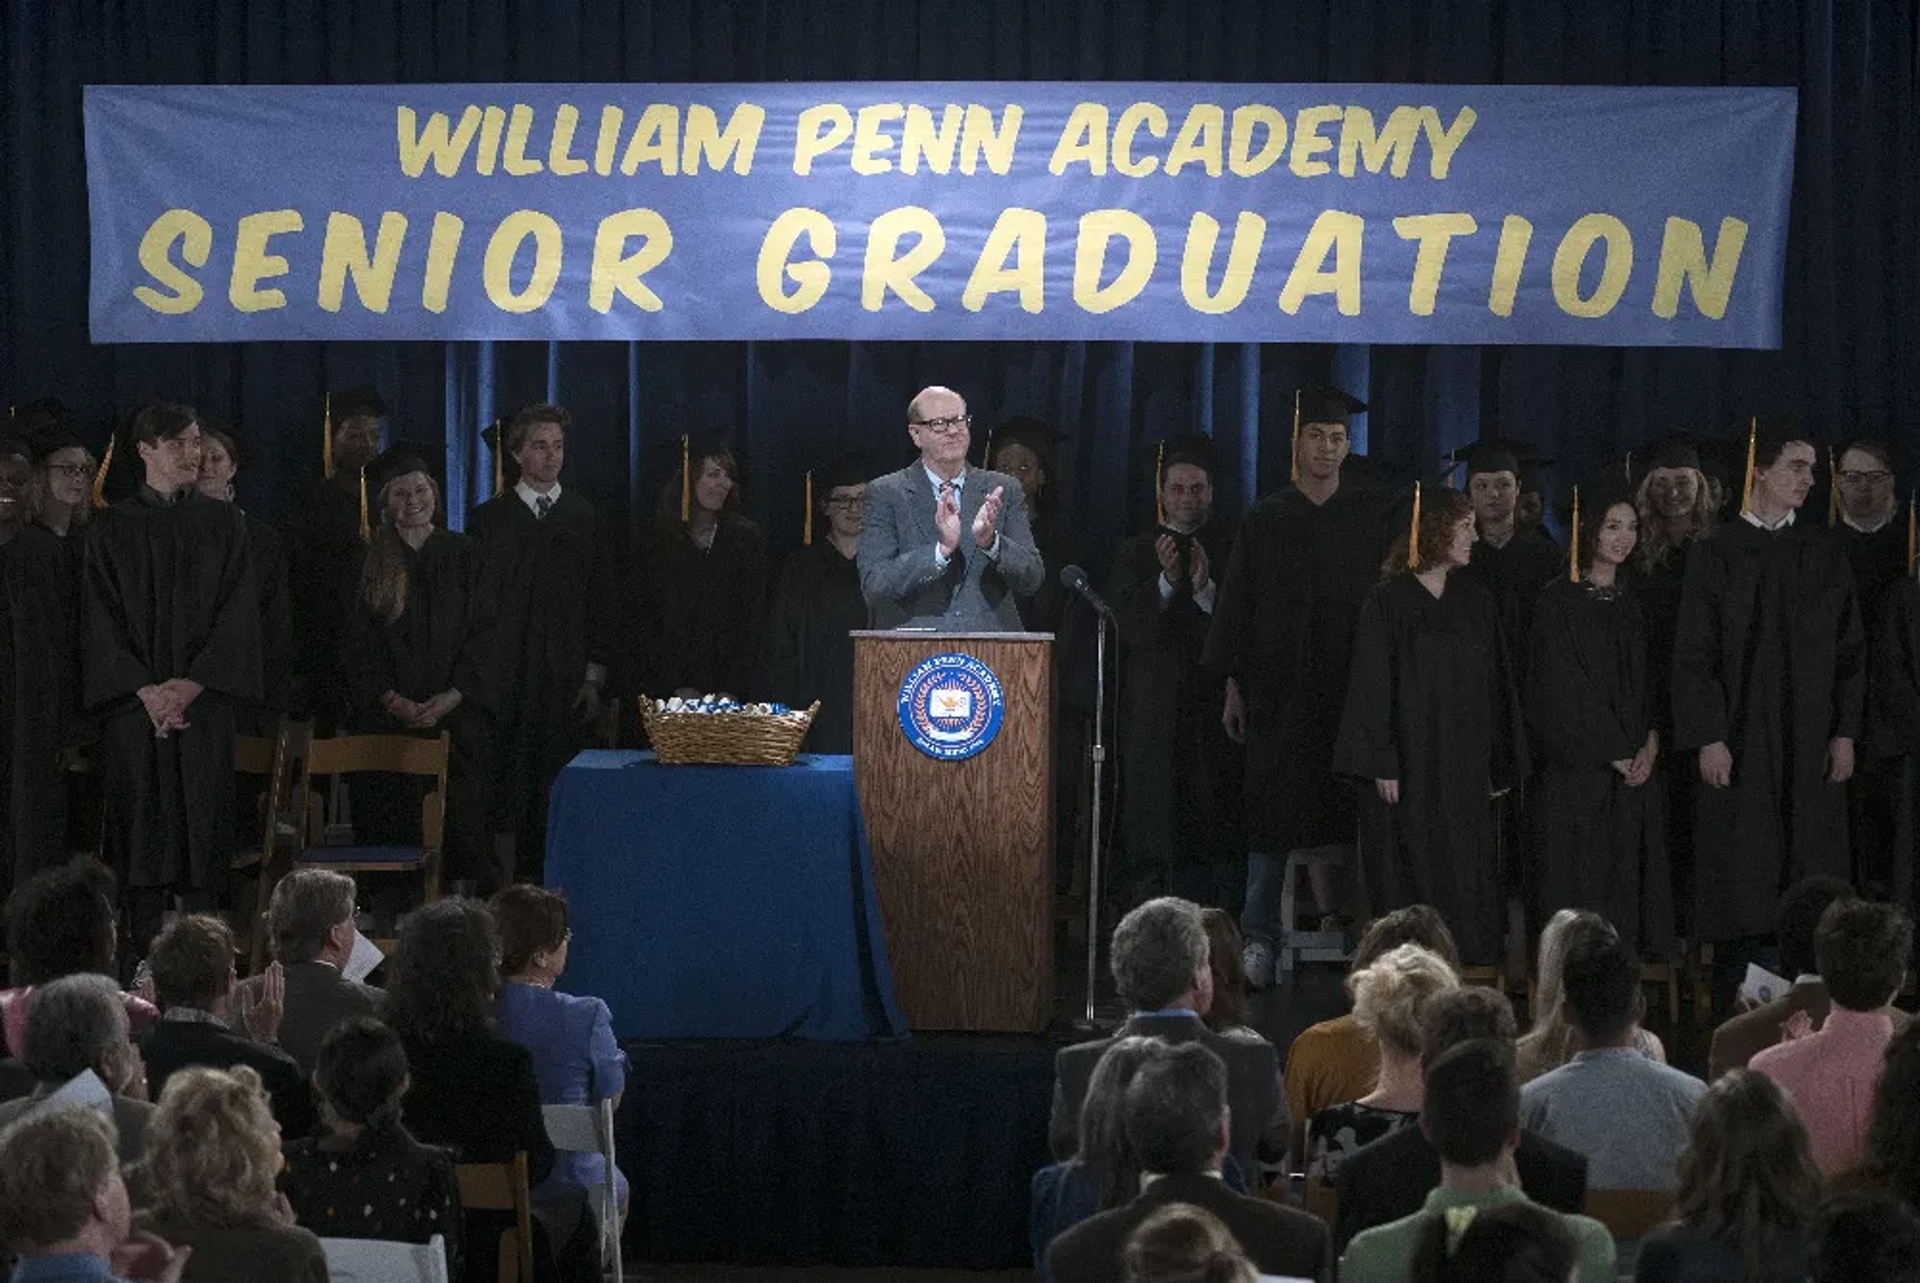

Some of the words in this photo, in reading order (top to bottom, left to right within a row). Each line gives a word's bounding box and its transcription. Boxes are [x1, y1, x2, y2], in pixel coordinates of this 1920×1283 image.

[397, 103, 765, 178] WILLIAM
[793, 102, 1024, 176] PENN
[1049, 102, 1477, 180] ACADEMY
[133, 208, 673, 315] SENIOR
[756, 206, 1748, 320] GRADUATION
